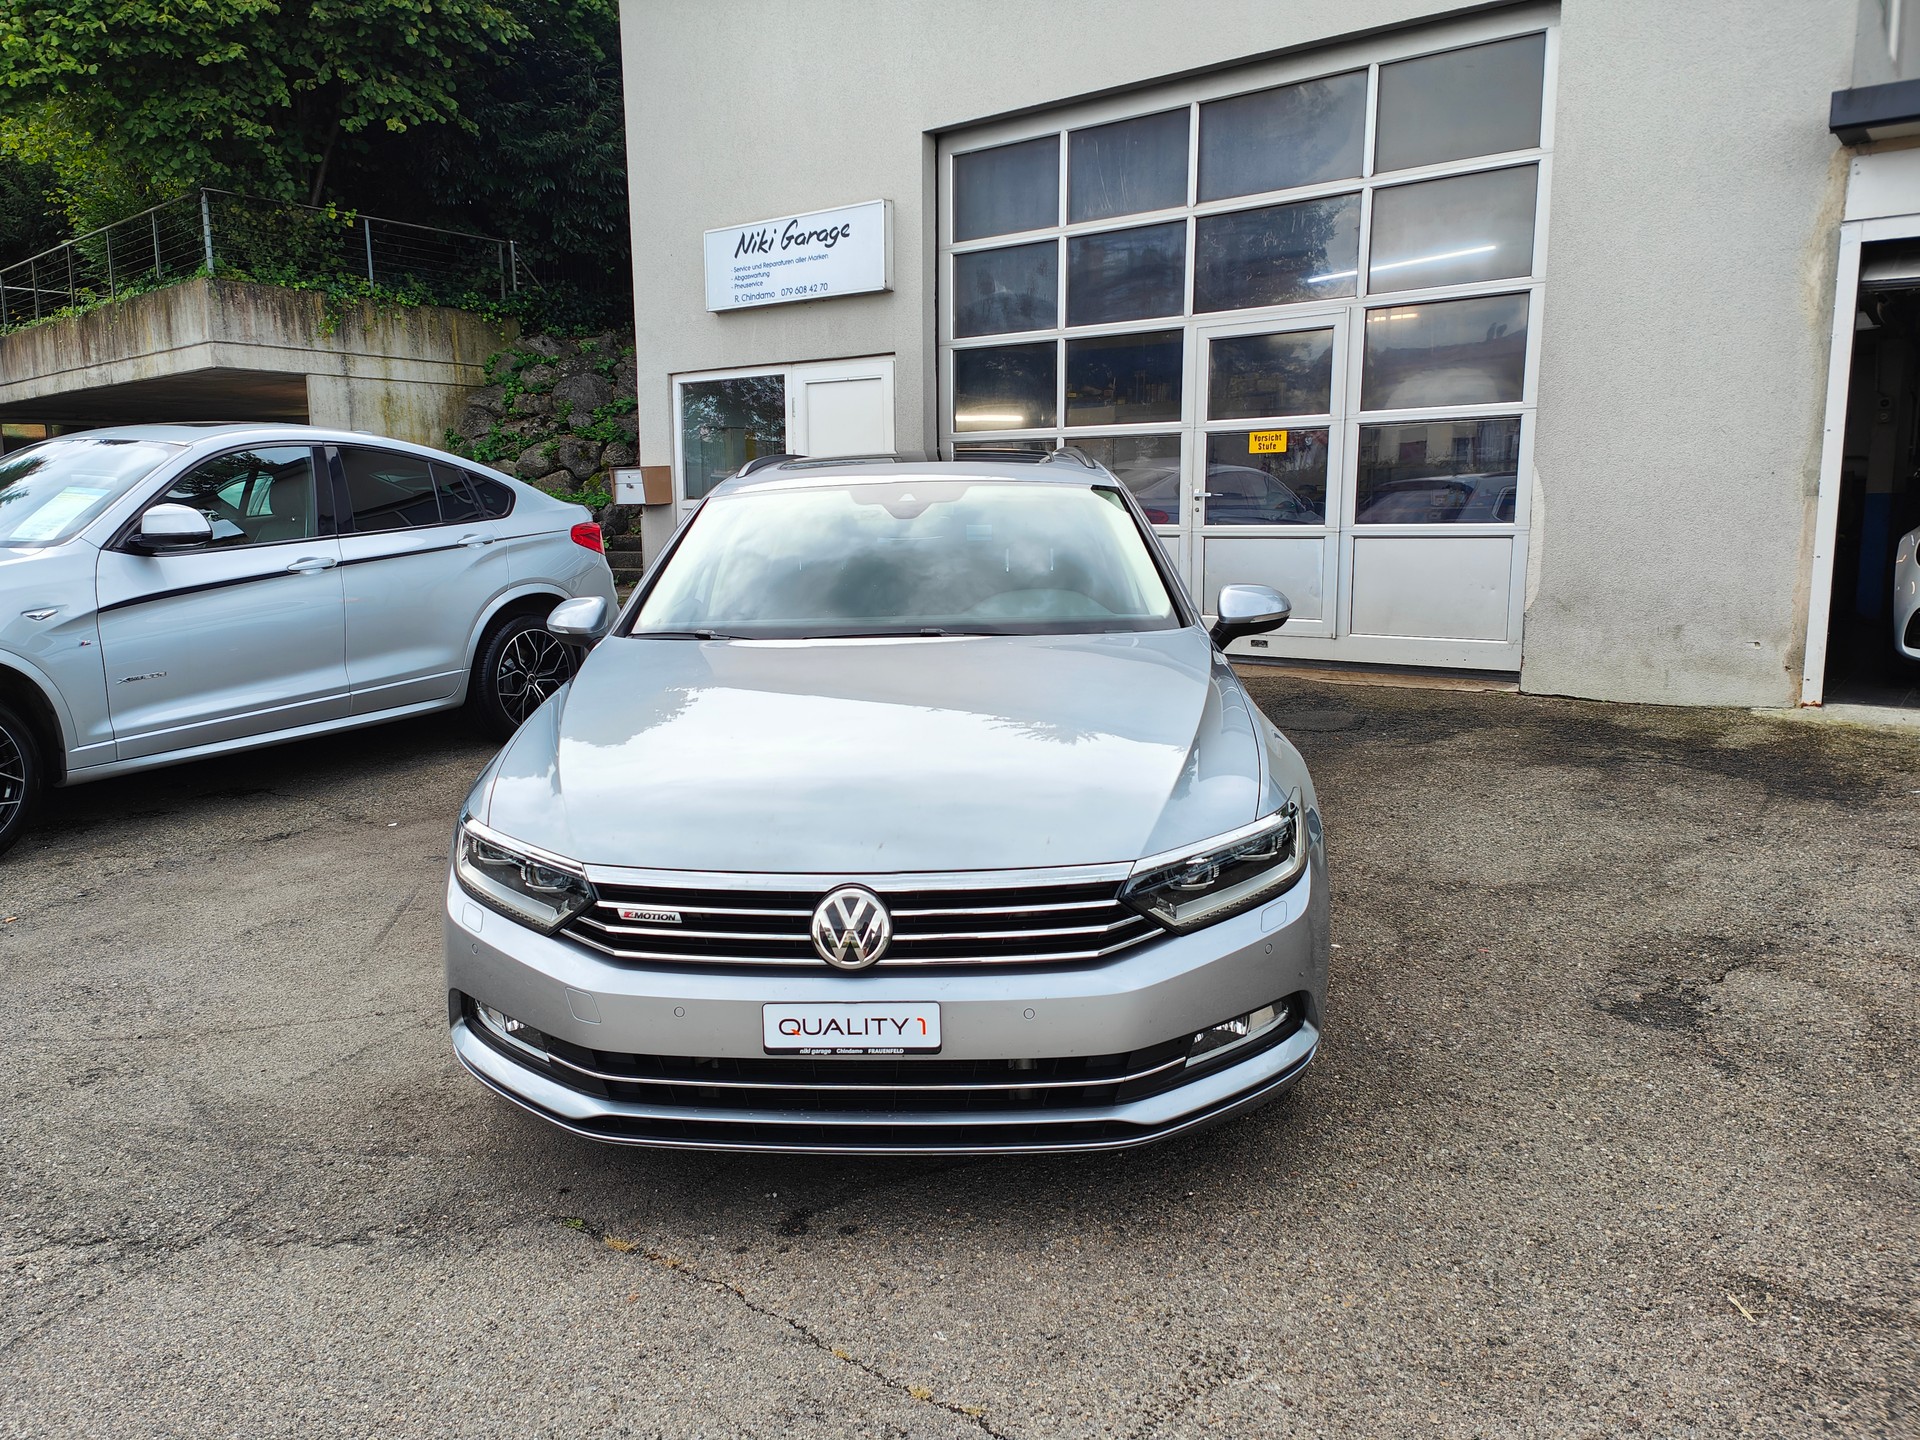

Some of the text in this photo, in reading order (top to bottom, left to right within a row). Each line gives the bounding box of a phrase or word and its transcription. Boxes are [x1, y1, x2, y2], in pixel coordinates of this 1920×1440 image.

[734, 218, 851, 259] Niki Garage
[733, 253, 829, 273] Service und Reparaturen aller Marken
[734, 271, 771, 282] Abgaswartung
[734, 280, 764, 290] Pneuservice
[741, 291, 776, 302] Chindamo
[780, 287, 794, 297] 079
[794, 285, 808, 295] 608
[809, 283, 818, 292] 42
[819, 282, 829, 291] 70
[1253, 433, 1282, 442] Vorsicht
[1257, 442, 1277, 451] Stufe
[778, 1017, 910, 1036] QUALITY
[811, 1048, 832, 1056] garage
